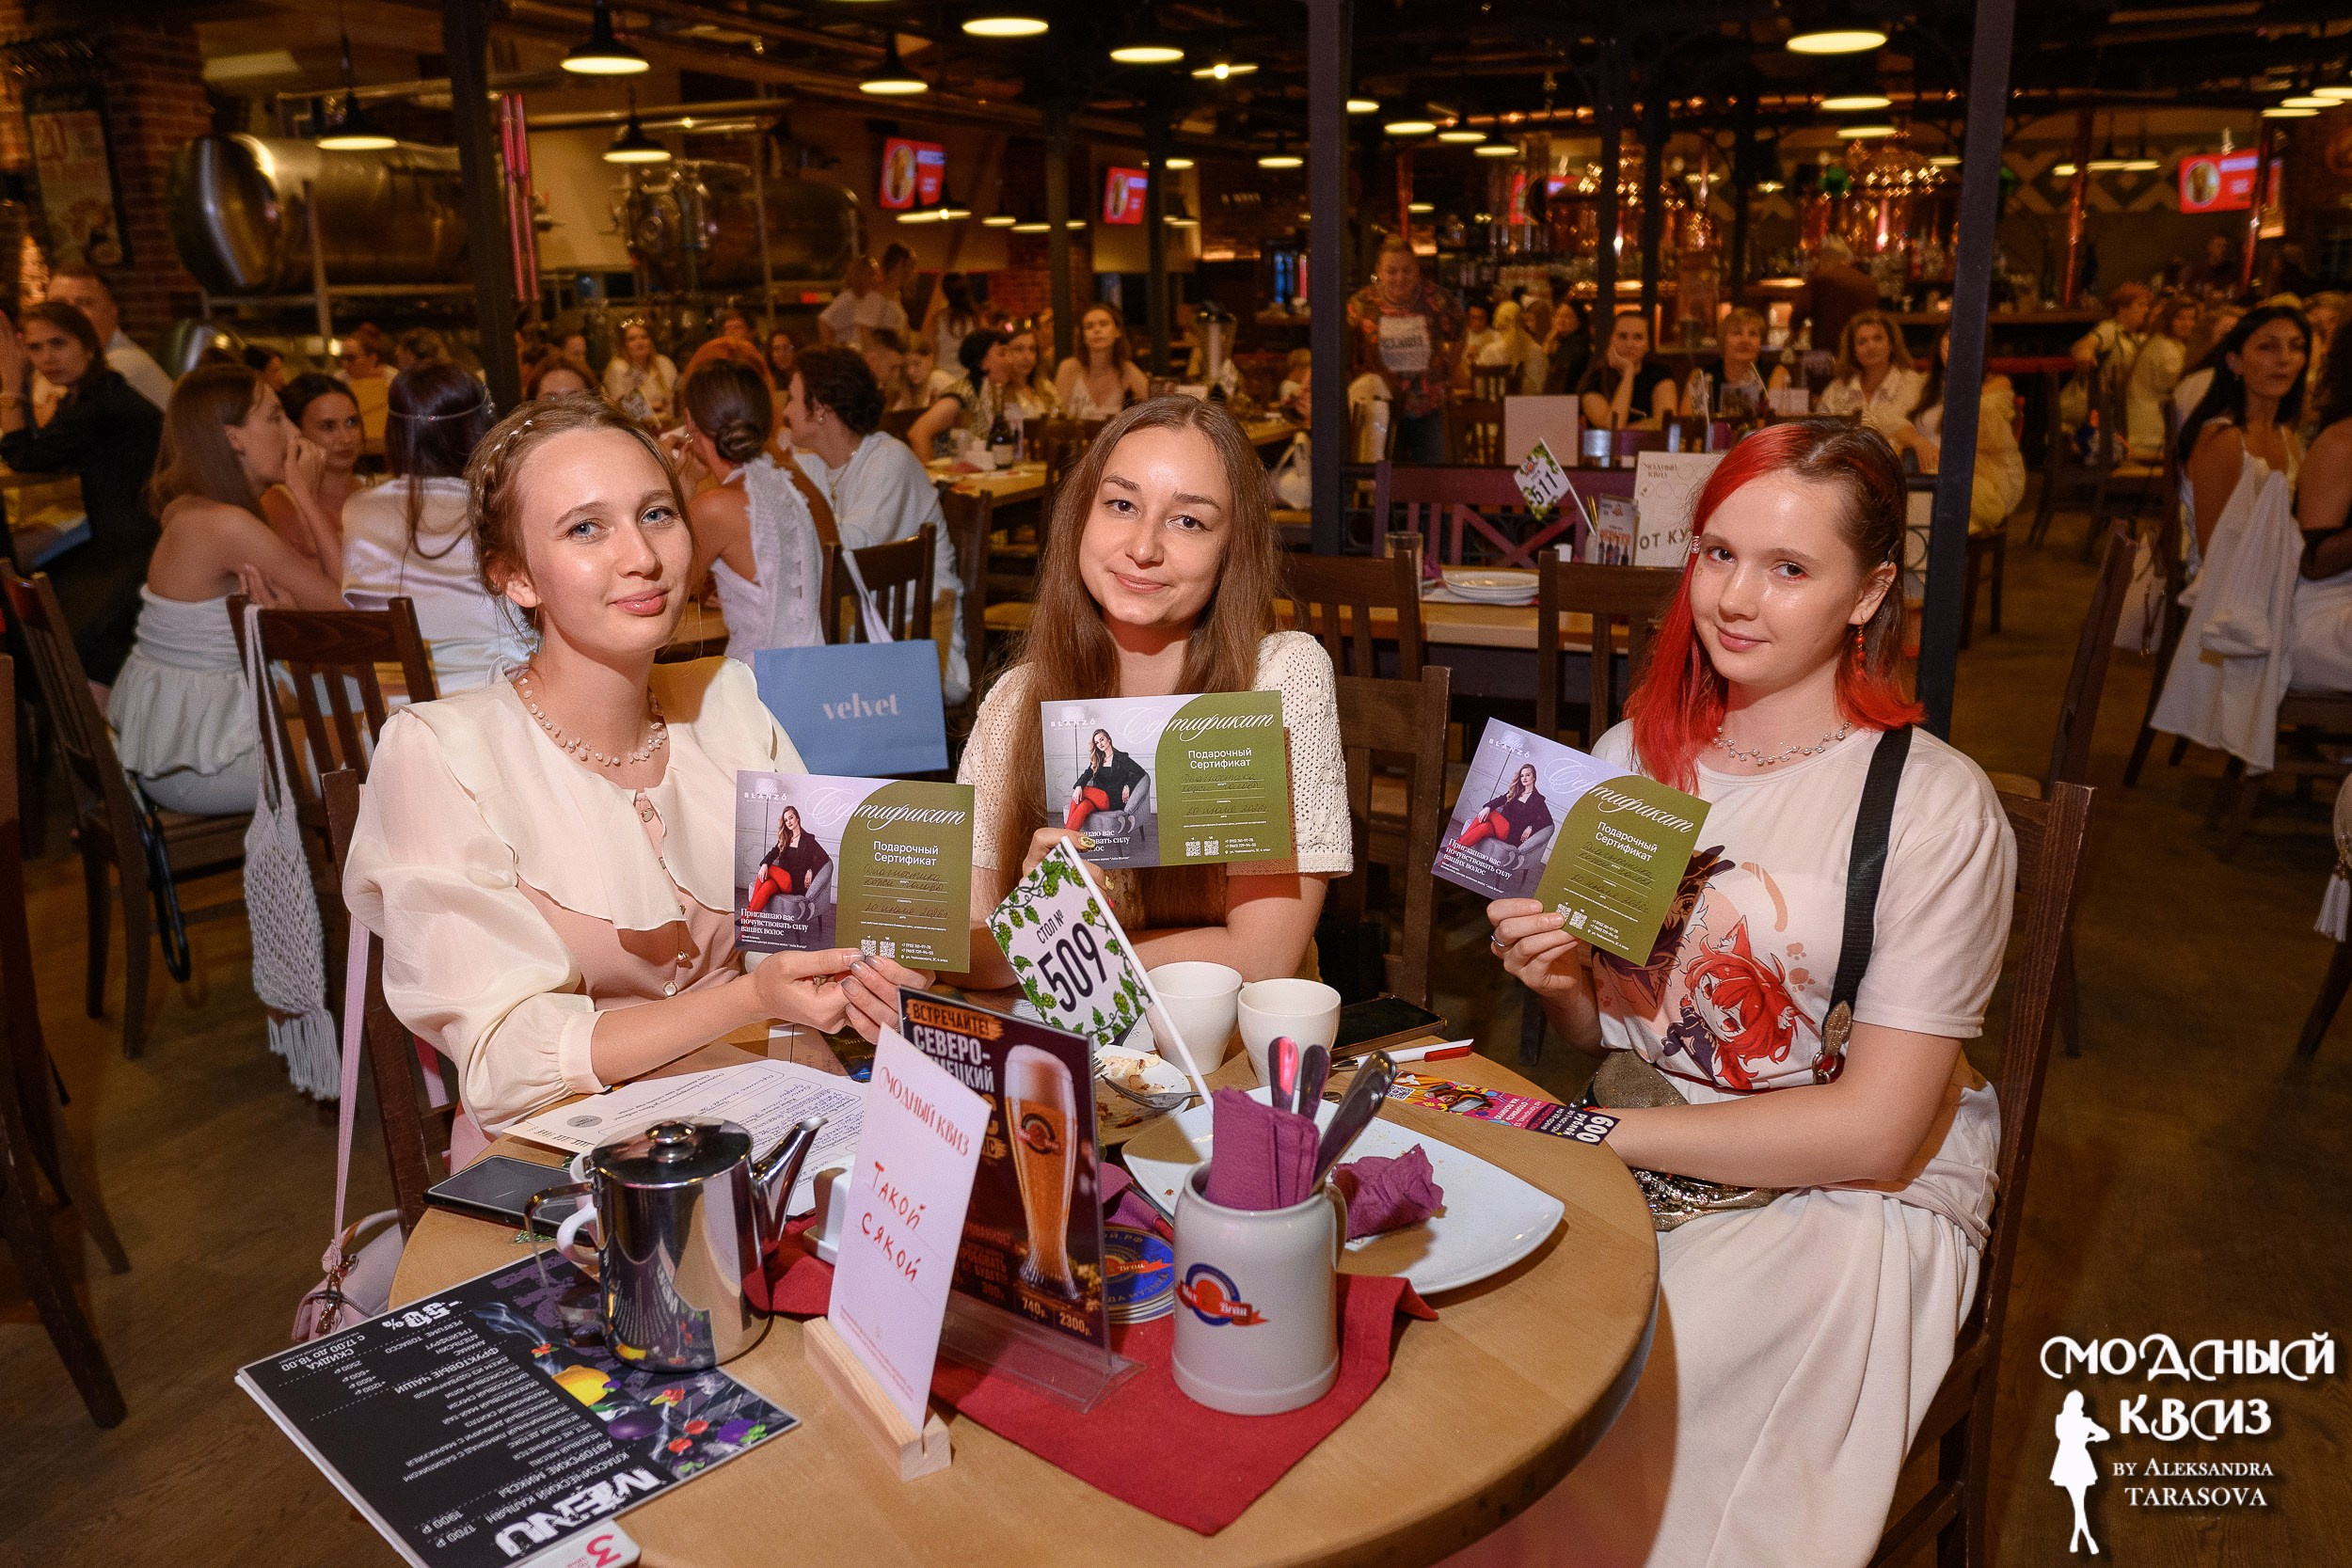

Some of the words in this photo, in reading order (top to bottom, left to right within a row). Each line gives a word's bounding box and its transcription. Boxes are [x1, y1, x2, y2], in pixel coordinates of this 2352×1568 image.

[1530, 470, 1558, 505] 511
[1640, 534, 1659, 550] ОТ
[823, 692, 898, 720] velvet
[1187, 747, 1252, 760] Подарочный
[1189, 757, 1250, 770] Сертификат
[872, 840, 939, 856] Подарочный
[1112, 835, 1130, 845] силу
[1594, 830, 1653, 863] Сертификат
[1596, 820, 1659, 853] Подарочный
[873, 851, 936, 867] Сертификат
[1442, 851, 1467, 867] ваших
[1465, 862, 1486, 876] волос
[1444, 845, 1496, 874] почувствовать
[1494, 866, 1512, 880] силу
[1447, 837, 1489, 863] Приглашаю
[1487, 855, 1502, 866] вас
[739, 917, 791, 930] почувствовать
[791, 922, 808, 932] силу
[740, 908, 782, 922] Приглашаю
[782, 913, 794, 922] вас
[739, 925, 763, 934] ваших
[763, 927, 784, 936] волос
[1036, 919, 1058, 944] СТОЛ
[1037, 922, 1107, 1013] 509
[913, 1004, 988, 1035] ВСТРЕЧАЙТЕ!
[913, 1025, 991, 1065] СЕВЕРО-
[933, 1056, 995, 1093] ЕЦКИЙ
[878, 1066, 935, 1128] МОДНЫЙ
[935, 1113, 970, 1157] КВИЗ
[1563, 1114, 1588, 1136] рублей
[1576, 1116, 1614, 1143] 600
[421, 1326, 474, 1351] ГРЕЙПФРУТ
[422, 1319, 465, 1338] PERFUME
[310, 1347, 329, 1358] до
[326, 1337, 358, 1353] 17.00
[382, 1335, 423, 1354] TOBACCO
[433, 1332, 481, 1354] АПЕЛЬСИН
[451, 1338, 488, 1356] АНАНАС
[278, 1354, 312, 1371] 18.00
[304, 1346, 356, 1370] СКИДКА
[429, 1345, 501, 1379] ФРУКТОВЫЕ
[392, 1374, 433, 1394] ЧАШИ
[543, 1437, 616, 1477] АВТОРСКИЕ
[495, 1469, 548, 1498] МИКСЫ
[532, 1449, 630, 1501] КЛАССИЧЕСКИЙ
[484, 1494, 537, 1524] КАЛЬЯН
[494, 1468, 665, 1558] MENU
[444, 1522, 478, 1543] 1700
